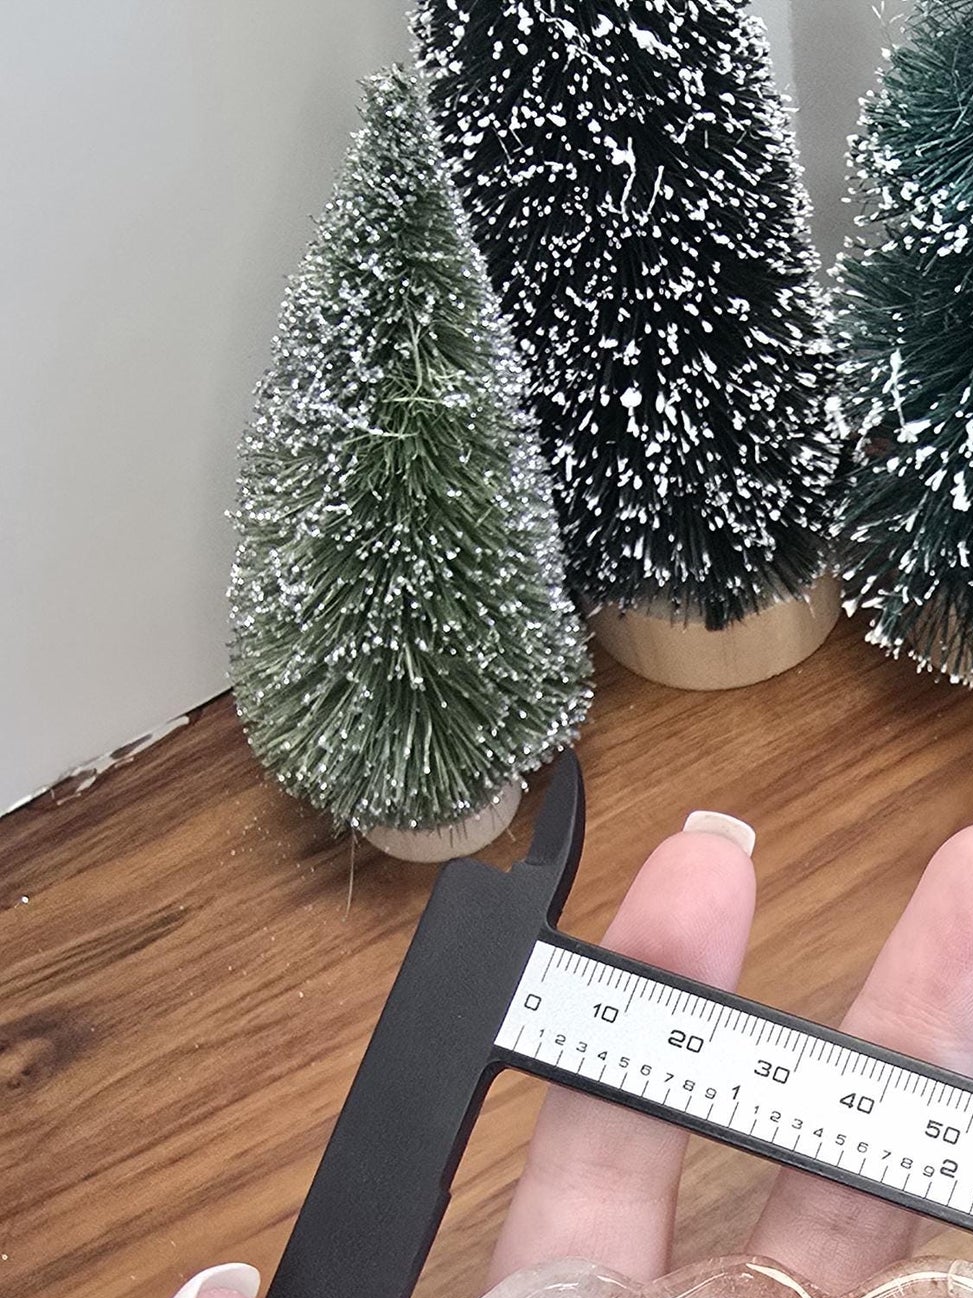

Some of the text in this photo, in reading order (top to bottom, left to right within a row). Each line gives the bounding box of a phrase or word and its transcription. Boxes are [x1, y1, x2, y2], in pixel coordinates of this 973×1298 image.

[524, 993, 542, 1011] 0
[592, 1003, 619, 1023] 10
[667, 1029, 704, 1053] 20
[753, 1059, 790, 1084] 30
[839, 1092, 875, 1114] 40
[924, 1119, 960, 1145] 50
[538, 1028, 545, 1038] 1
[554, 1034, 566, 1046] 2
[576, 1041, 588, 1053] 3
[597, 1051, 608, 1061] 4
[618, 1057, 630, 1068] 5
[640, 1064, 652, 1076] 6
[663, 1072, 674, 1083] 7
[682, 1080, 696, 1092] 8
[704, 1088, 717, 1100] 9
[731, 1085, 741, 1101] 1
[753, 1105, 760, 1115] 1
[770, 1111, 782, 1123] 2
[791, 1118, 803, 1130] 3
[813, 1127, 824, 1138] 4
[835, 1134, 847, 1146] 5
[856, 1142, 869, 1153] 6
[881, 1150, 892, 1160] 7
[900, 1157, 913, 1169] 8
[922, 1165, 935, 1178] 9
[940, 1159, 958, 1178] 2
